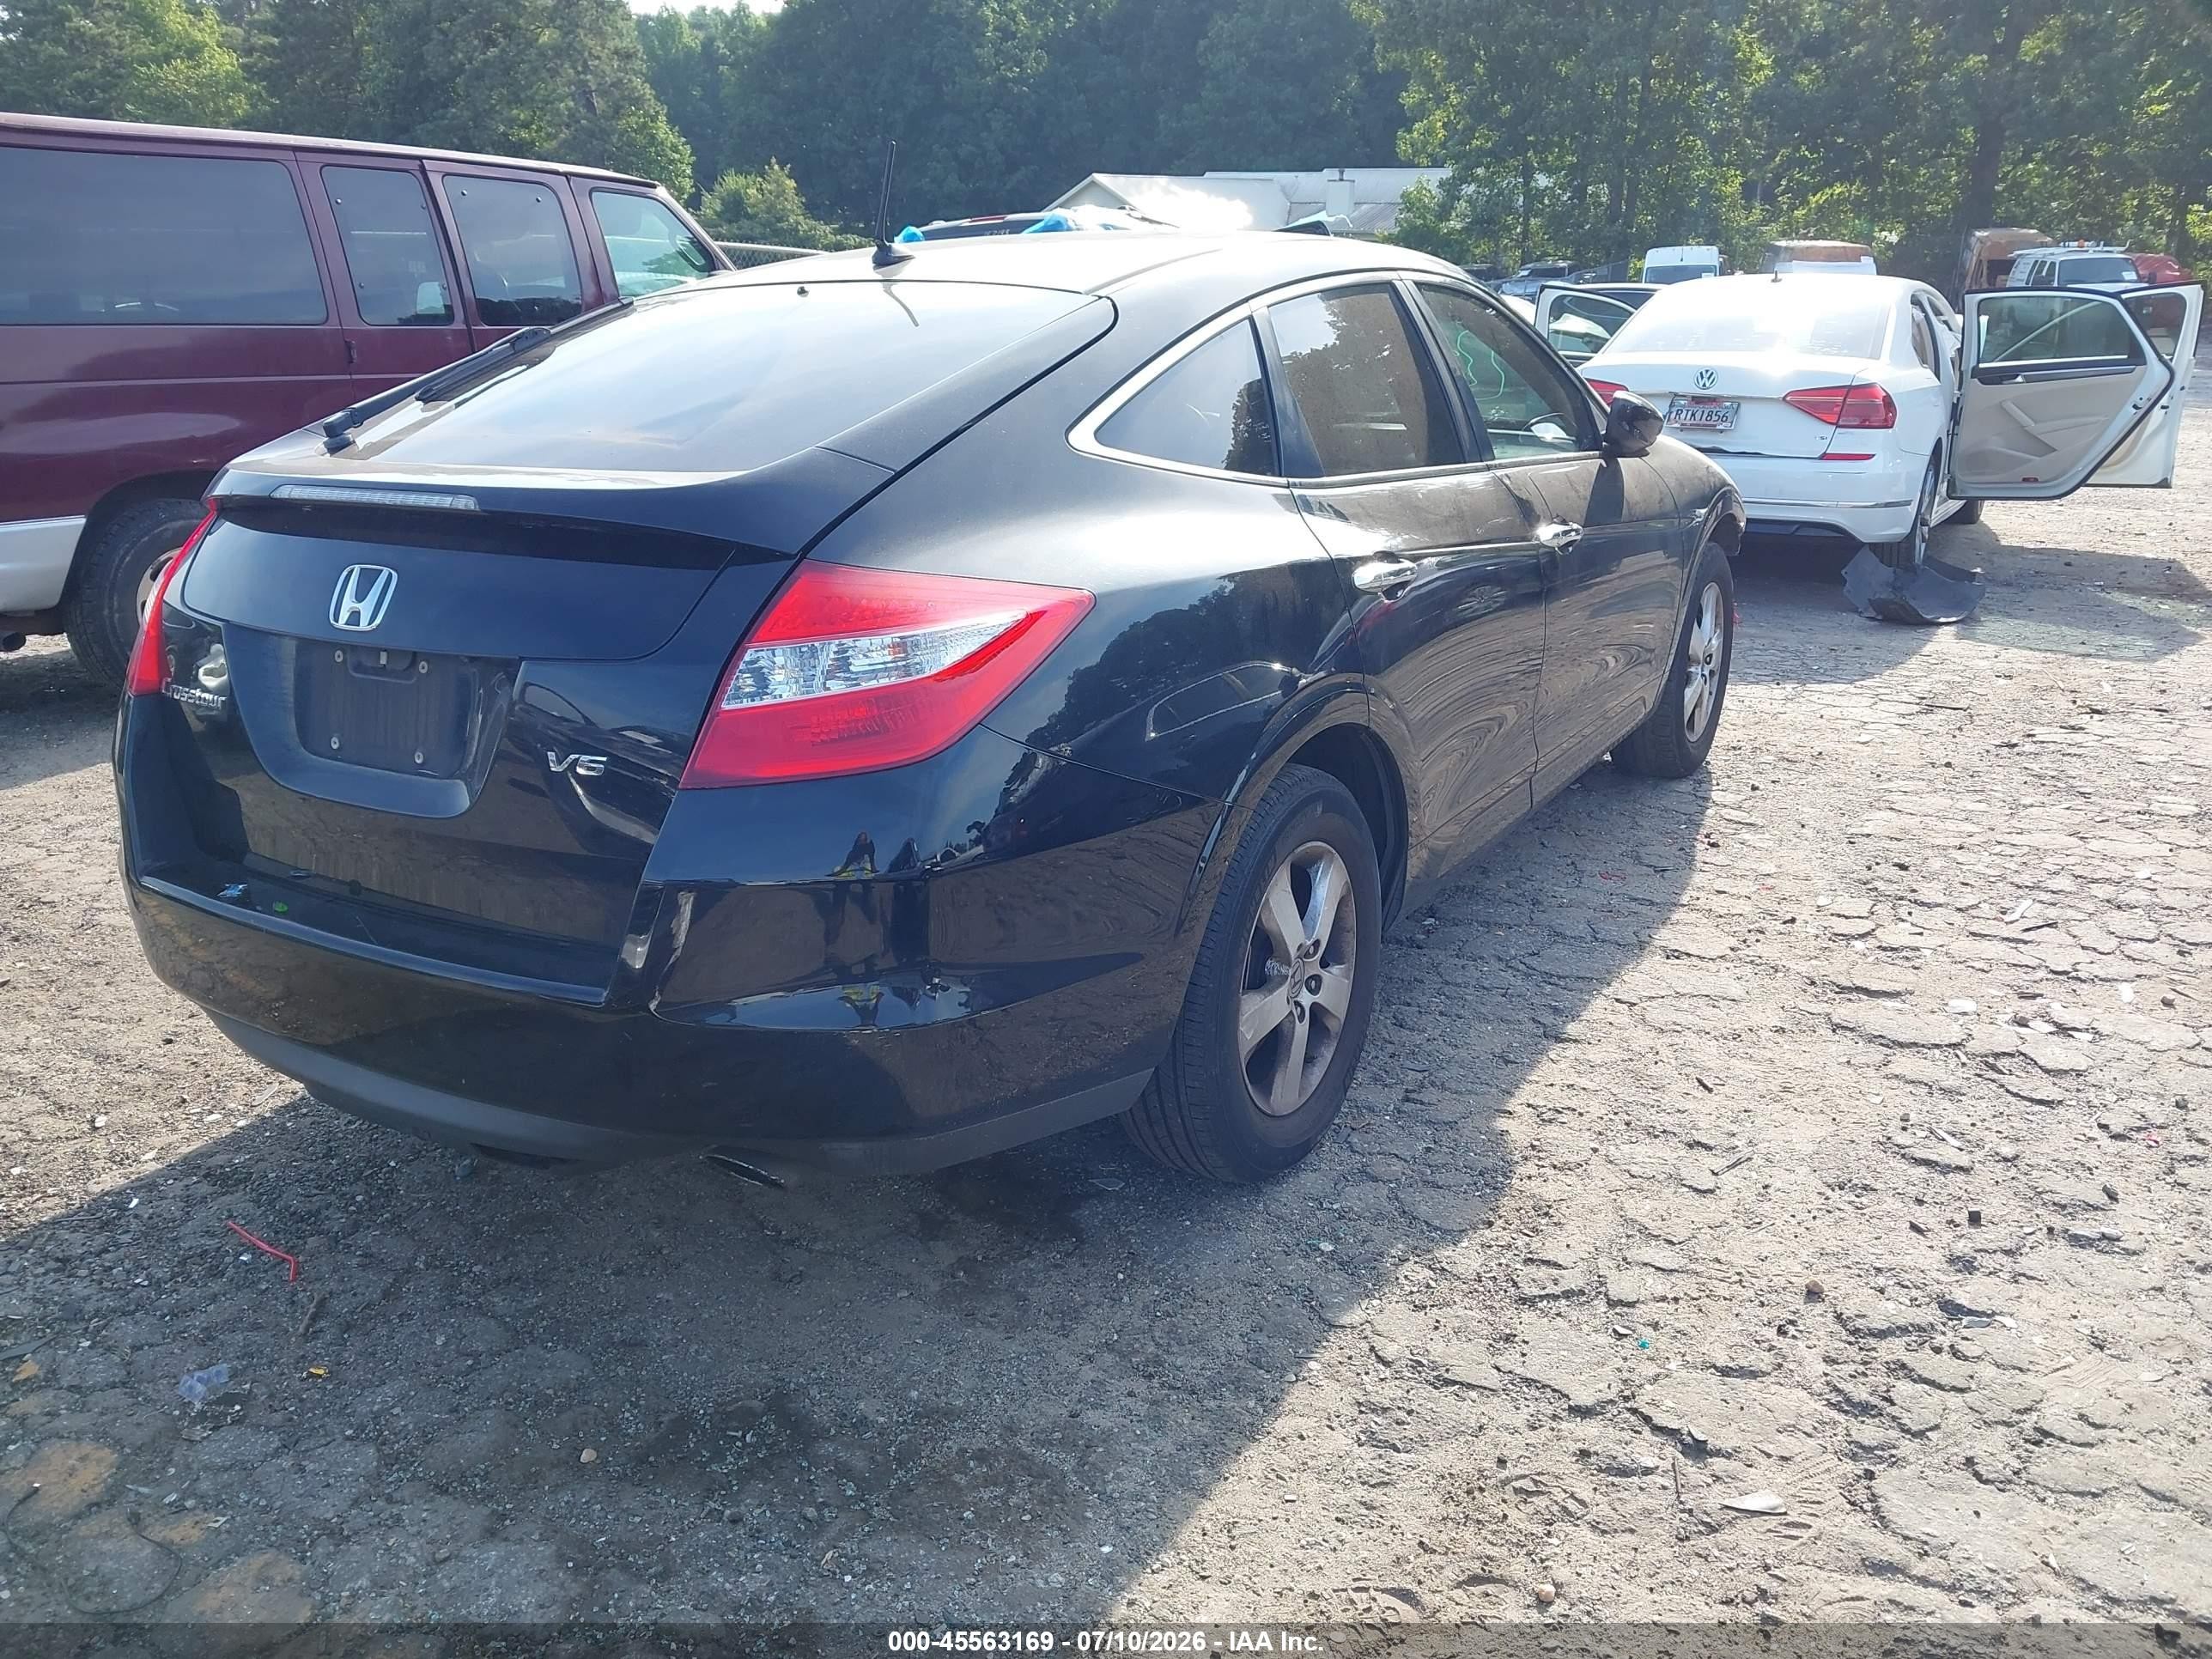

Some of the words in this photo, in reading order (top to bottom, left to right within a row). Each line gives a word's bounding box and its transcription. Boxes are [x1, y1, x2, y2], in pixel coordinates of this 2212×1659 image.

[1674, 408, 1729, 422] RTK1856
[161, 677, 228, 710] Crosstour
[546, 751, 608, 776] V6
